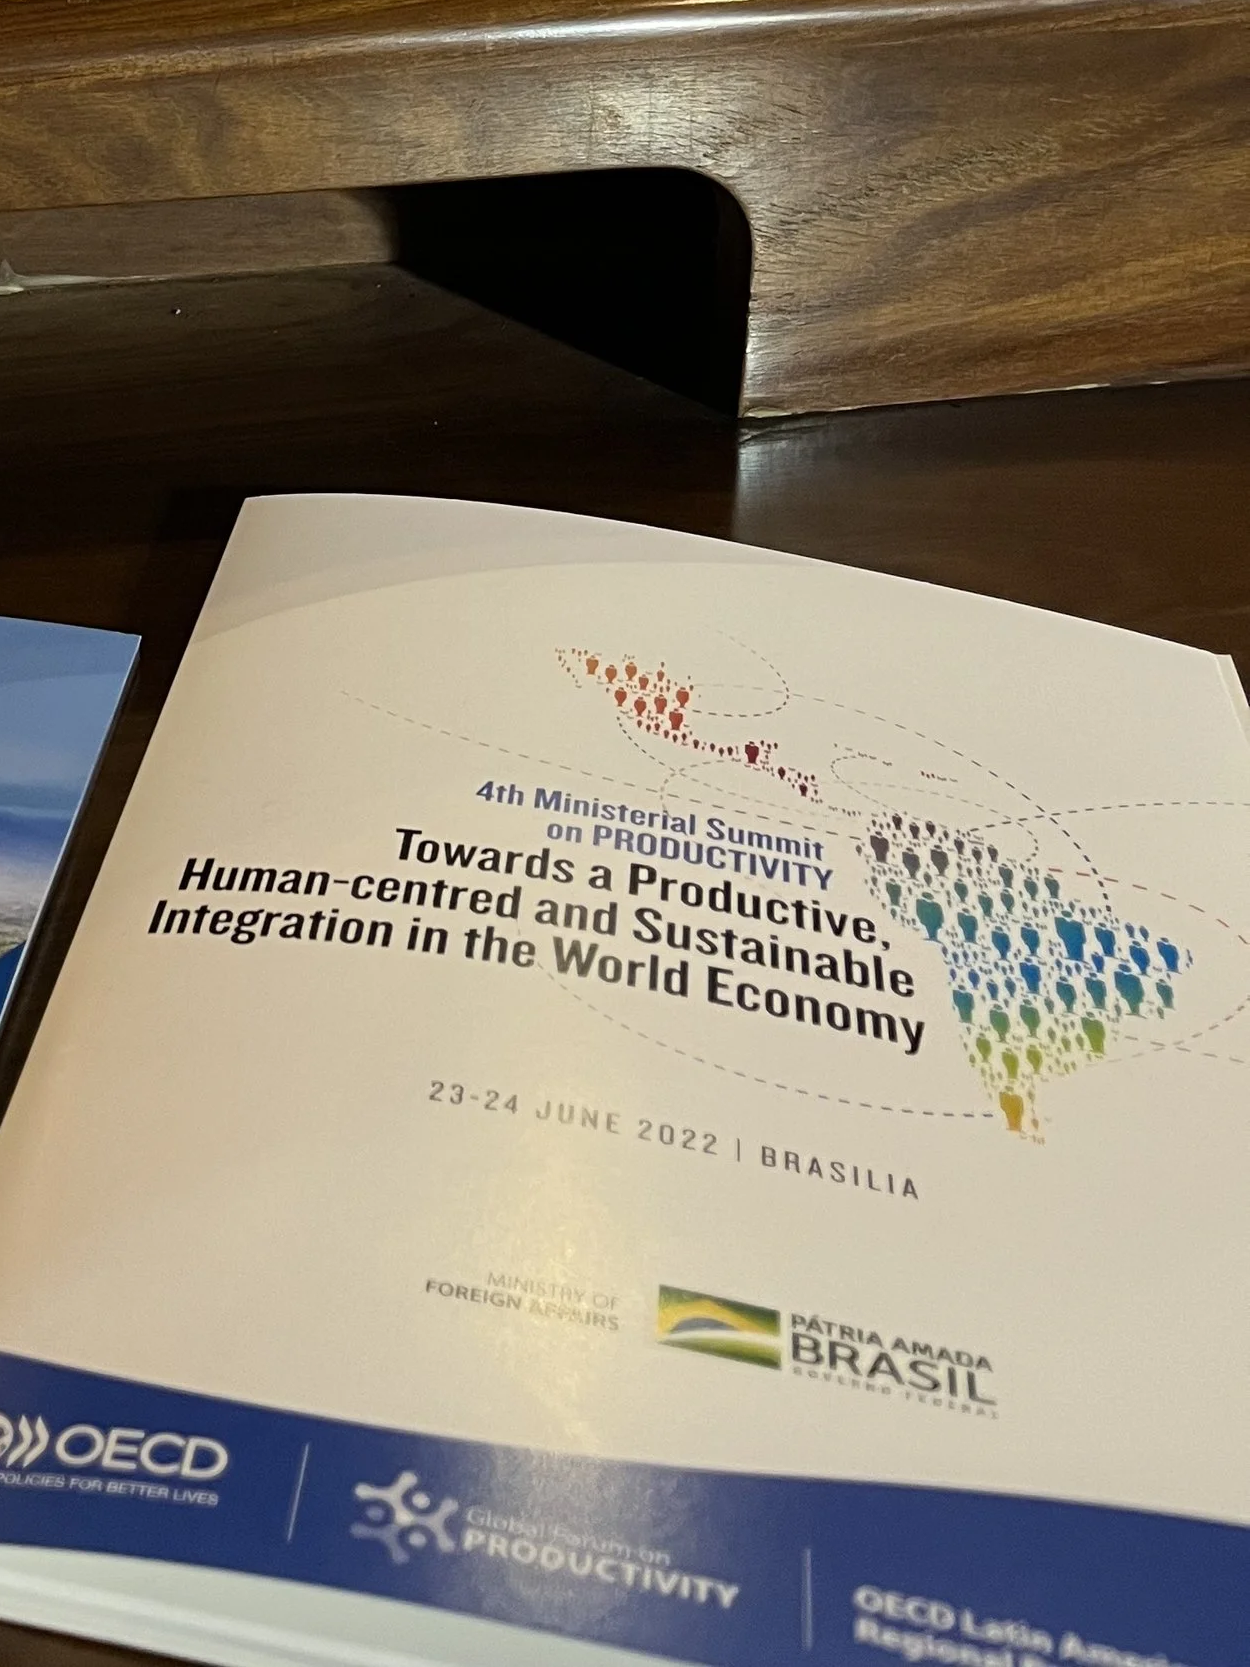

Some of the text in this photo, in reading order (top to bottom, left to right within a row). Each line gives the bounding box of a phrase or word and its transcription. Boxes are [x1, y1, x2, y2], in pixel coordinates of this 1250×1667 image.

[476, 780, 826, 862] 4th Ministerial Summit
[395, 828, 891, 952] Towards a Productive,
[546, 822, 835, 891] on PRODUCTIVITY
[178, 857, 916, 998] Human-centred and Sustainable
[148, 900, 926, 1056] Integration in the World Economy
[429, 1080, 519, 1115] 23-24
[535, 1098, 622, 1135] JUNE
[638, 1119, 719, 1156] 2022
[761, 1145, 920, 1200] BRASILIA
[425, 1279, 620, 1332] FOREIGN AFFAIRS
[487, 1271, 622, 1311] MINISTRY OF
[791, 1313, 994, 1373] PÁTRIA AMADA
[792, 1333, 998, 1406] BRASIL
[55, 1424, 230, 1480] OECD
[68, 1477, 103, 1491] FOR
[106, 1481, 170, 1500] BETTER
[172, 1489, 220, 1507] LIVES
[462, 1527, 742, 1610] PRODUCTIVITY
[465, 1506, 546, 1539] Global
[636, 1546, 672, 1568] on
[852, 1584, 956, 1633] OECD
